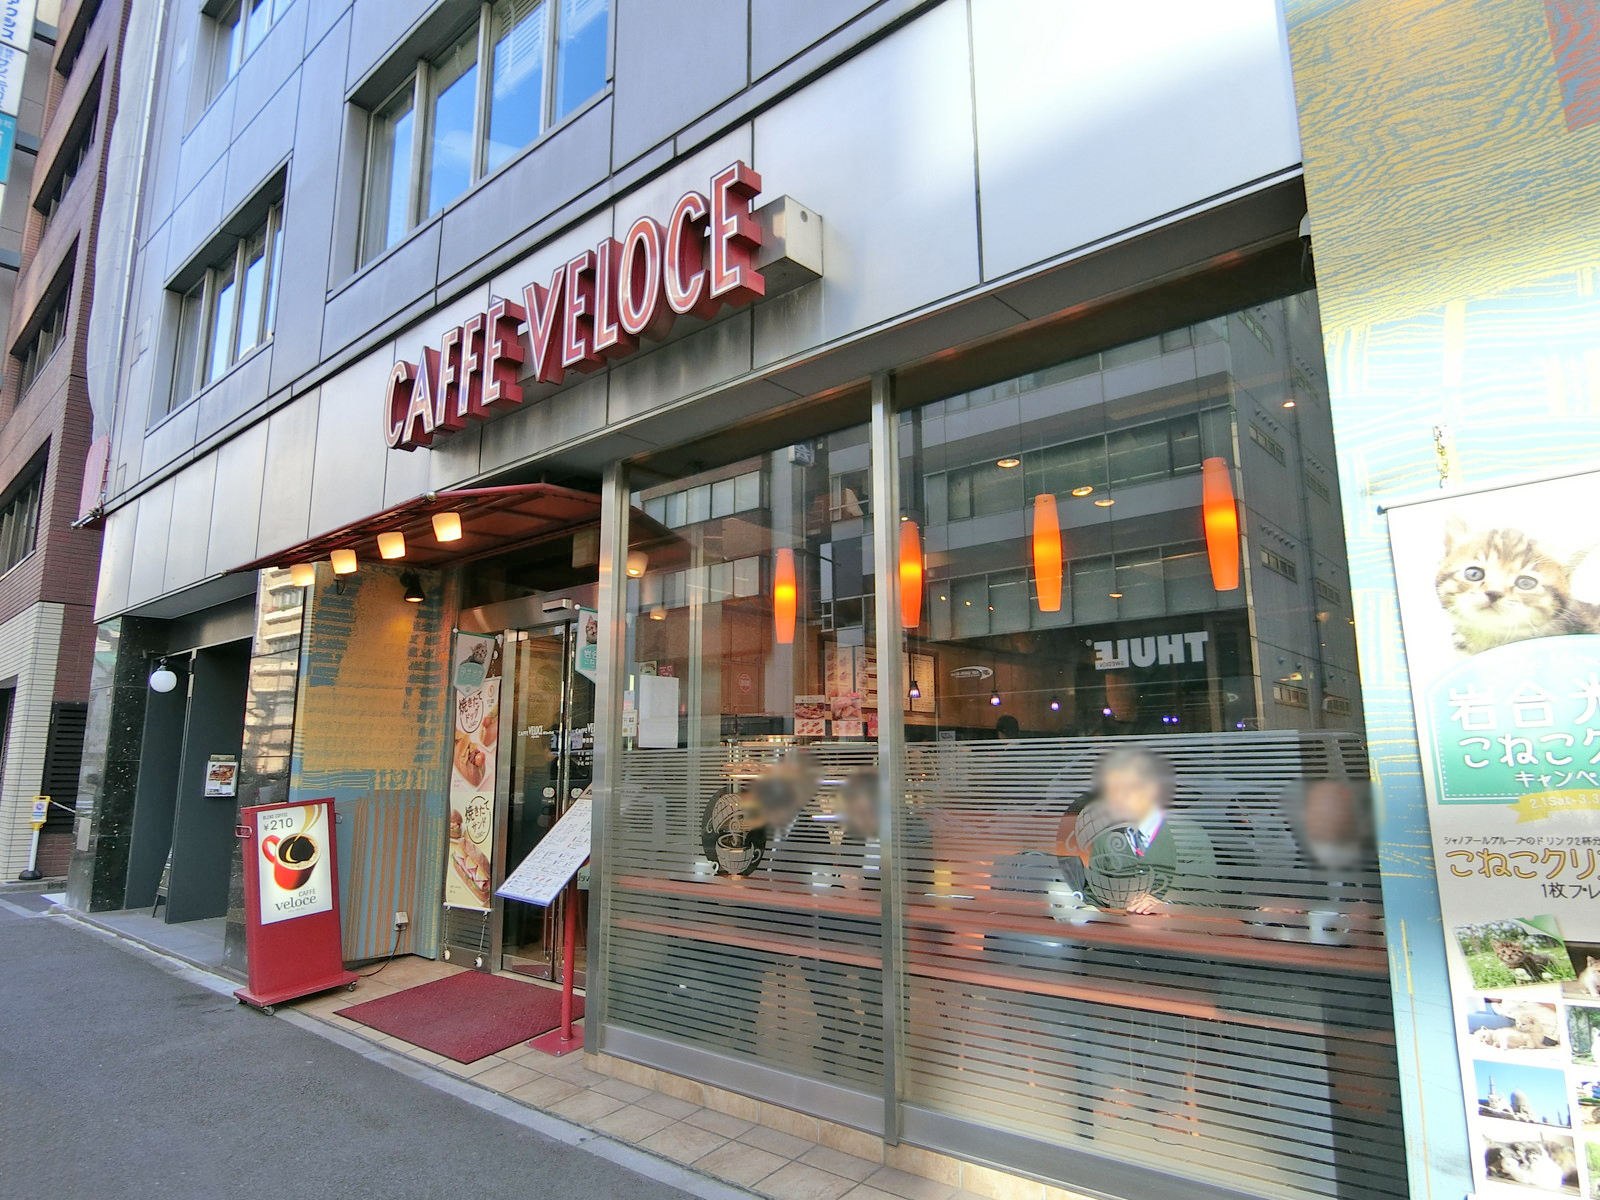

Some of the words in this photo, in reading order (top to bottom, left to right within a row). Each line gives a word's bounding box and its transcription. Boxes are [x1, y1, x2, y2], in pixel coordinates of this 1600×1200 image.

[522, 160, 764, 385] VELOCE
[1514, 769, 1600, 788] キャンペ
[465, 800, 490, 824] 焼きたて
[263, 817, 294, 831] ¥210
[1445, 847, 1600, 880] こねこクリ
[275, 896, 317, 910] veloce
